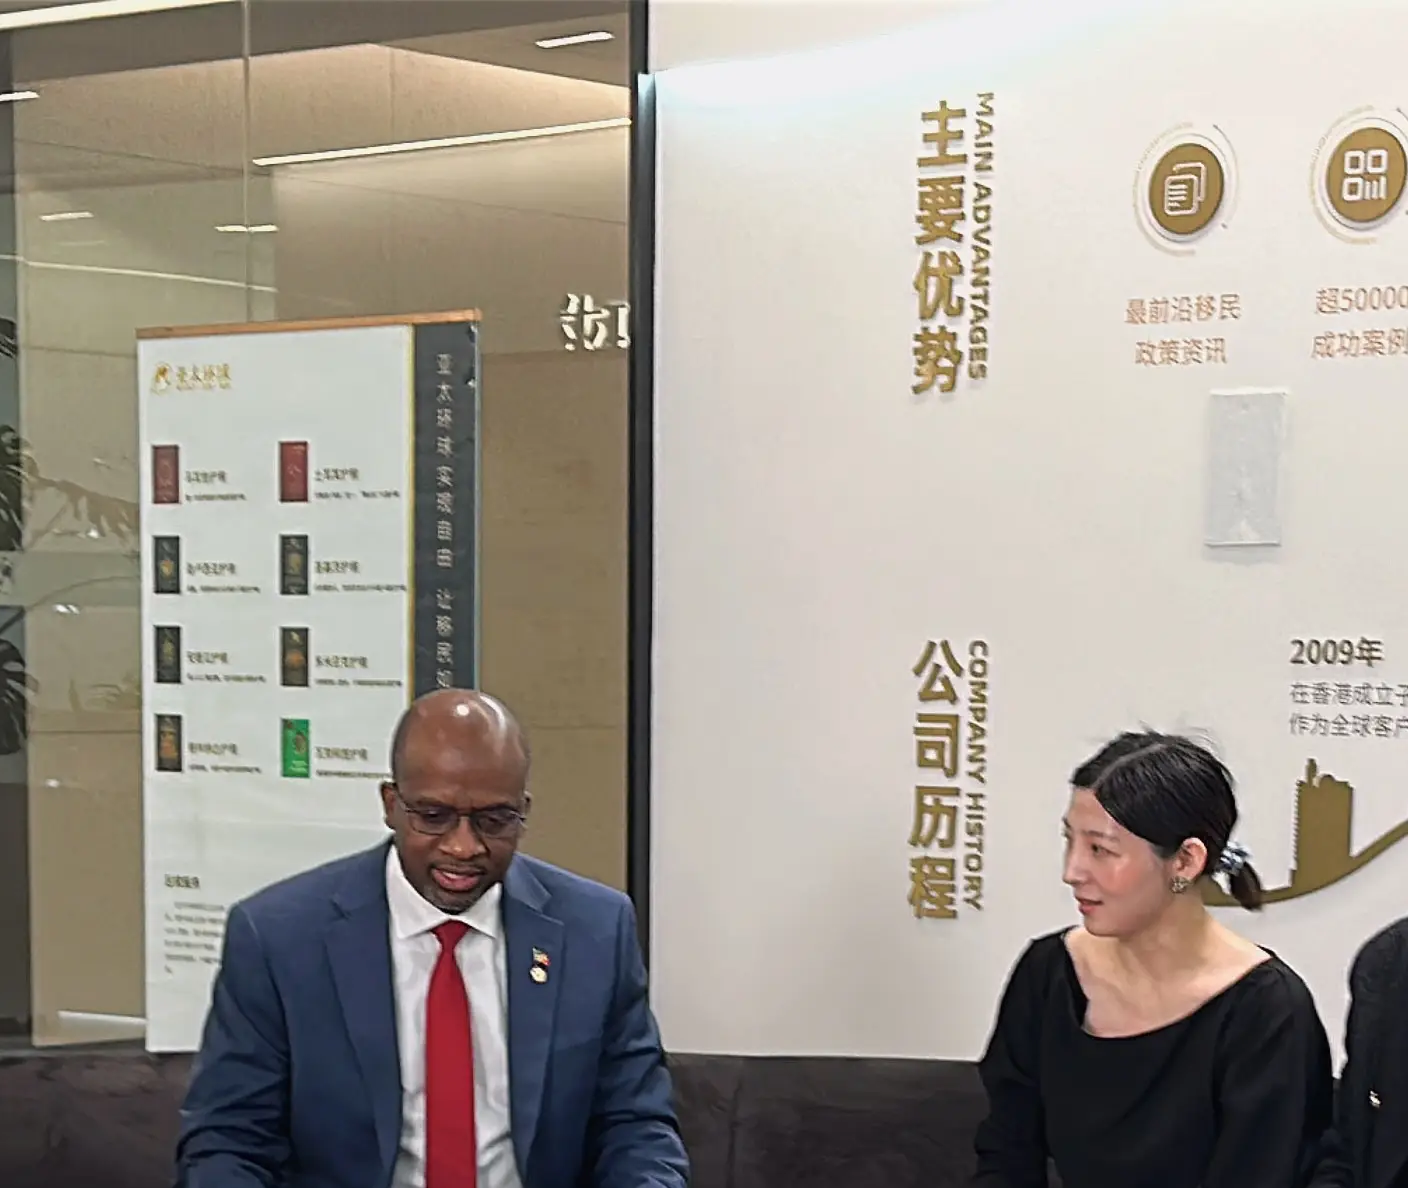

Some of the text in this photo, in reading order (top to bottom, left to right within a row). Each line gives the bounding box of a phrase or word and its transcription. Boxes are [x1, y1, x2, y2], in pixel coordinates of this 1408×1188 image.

[912, 100, 968, 395] 主要优势
[968, 92, 994, 380] MAIN ADVANTAGES
[1124, 292, 1242, 324] 最前沿移民
[1135, 337, 1228, 365] 政策资讯
[907, 639, 965, 920] 公司历程
[963, 640, 989, 911] COMPANY HISTORY
[1290, 636, 1385, 668] 2009年
